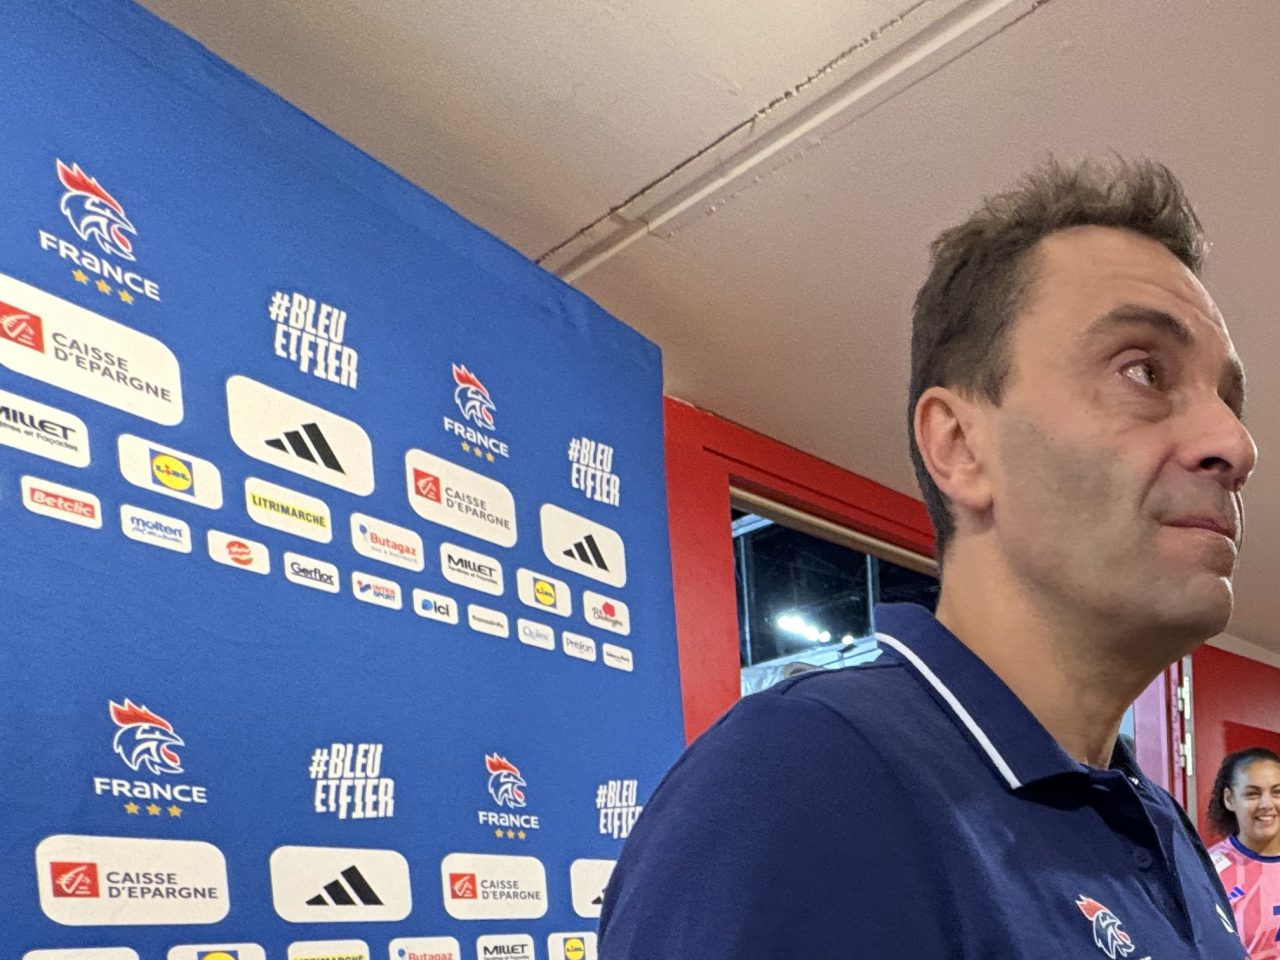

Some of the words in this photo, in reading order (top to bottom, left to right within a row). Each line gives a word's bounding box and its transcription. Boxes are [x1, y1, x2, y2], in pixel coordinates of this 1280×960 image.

[269, 291, 346, 343] #BLEU
[52, 332, 128, 372] CAISSE
[54, 348, 171, 401] D'EPARGNE
[568, 437, 613, 472] #BLEU
[33, 490, 93, 516] Betclic
[445, 486, 486, 510] CAISSE
[446, 499, 511, 529] D'EPARGNE
[131, 516, 182, 537] molten
[370, 532, 416, 556] Butagaz
[290, 562, 334, 583] Gerflor
[448, 554, 496, 577] MILLET
[309, 743, 383, 779] #BLEU
[596, 780, 638, 808] #BLEU
[106, 871, 177, 885] CAISSE
[480, 879, 519, 890] CAISSE
[107, 885, 218, 899] D'EPARGNE
[482, 890, 541, 900] D'EPARGNE
[483, 944, 528, 955] MILLET
